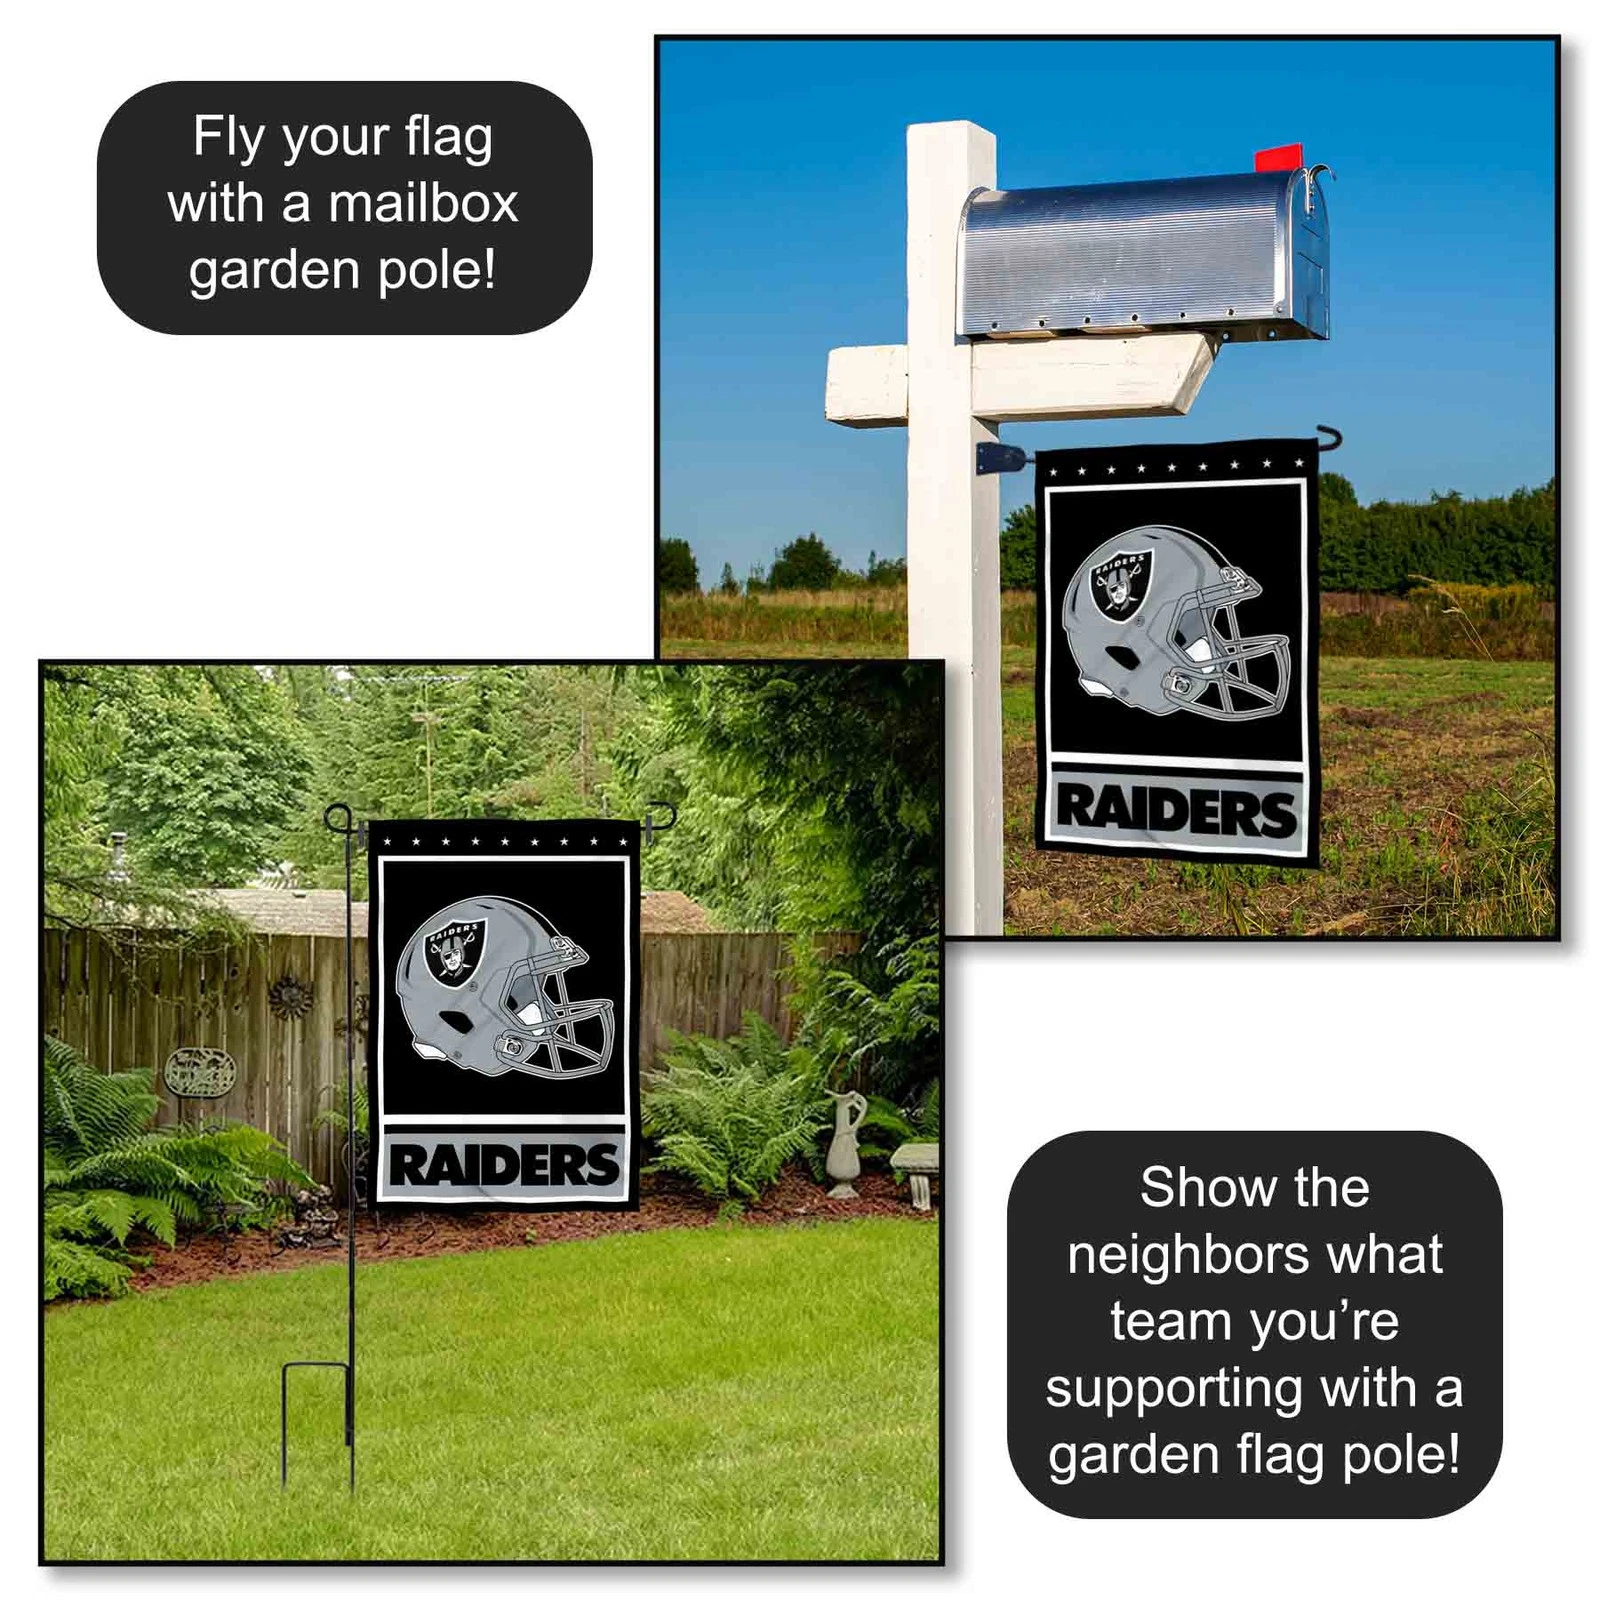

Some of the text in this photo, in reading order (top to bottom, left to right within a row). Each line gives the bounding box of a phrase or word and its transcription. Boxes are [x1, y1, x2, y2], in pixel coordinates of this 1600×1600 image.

[1095, 554, 1145, 574] RAIDERS
[1057, 783, 1298, 839] RAIDERS
[429, 923, 478, 942] RAIDERS
[389, 1142, 620, 1187] RAIDERS
